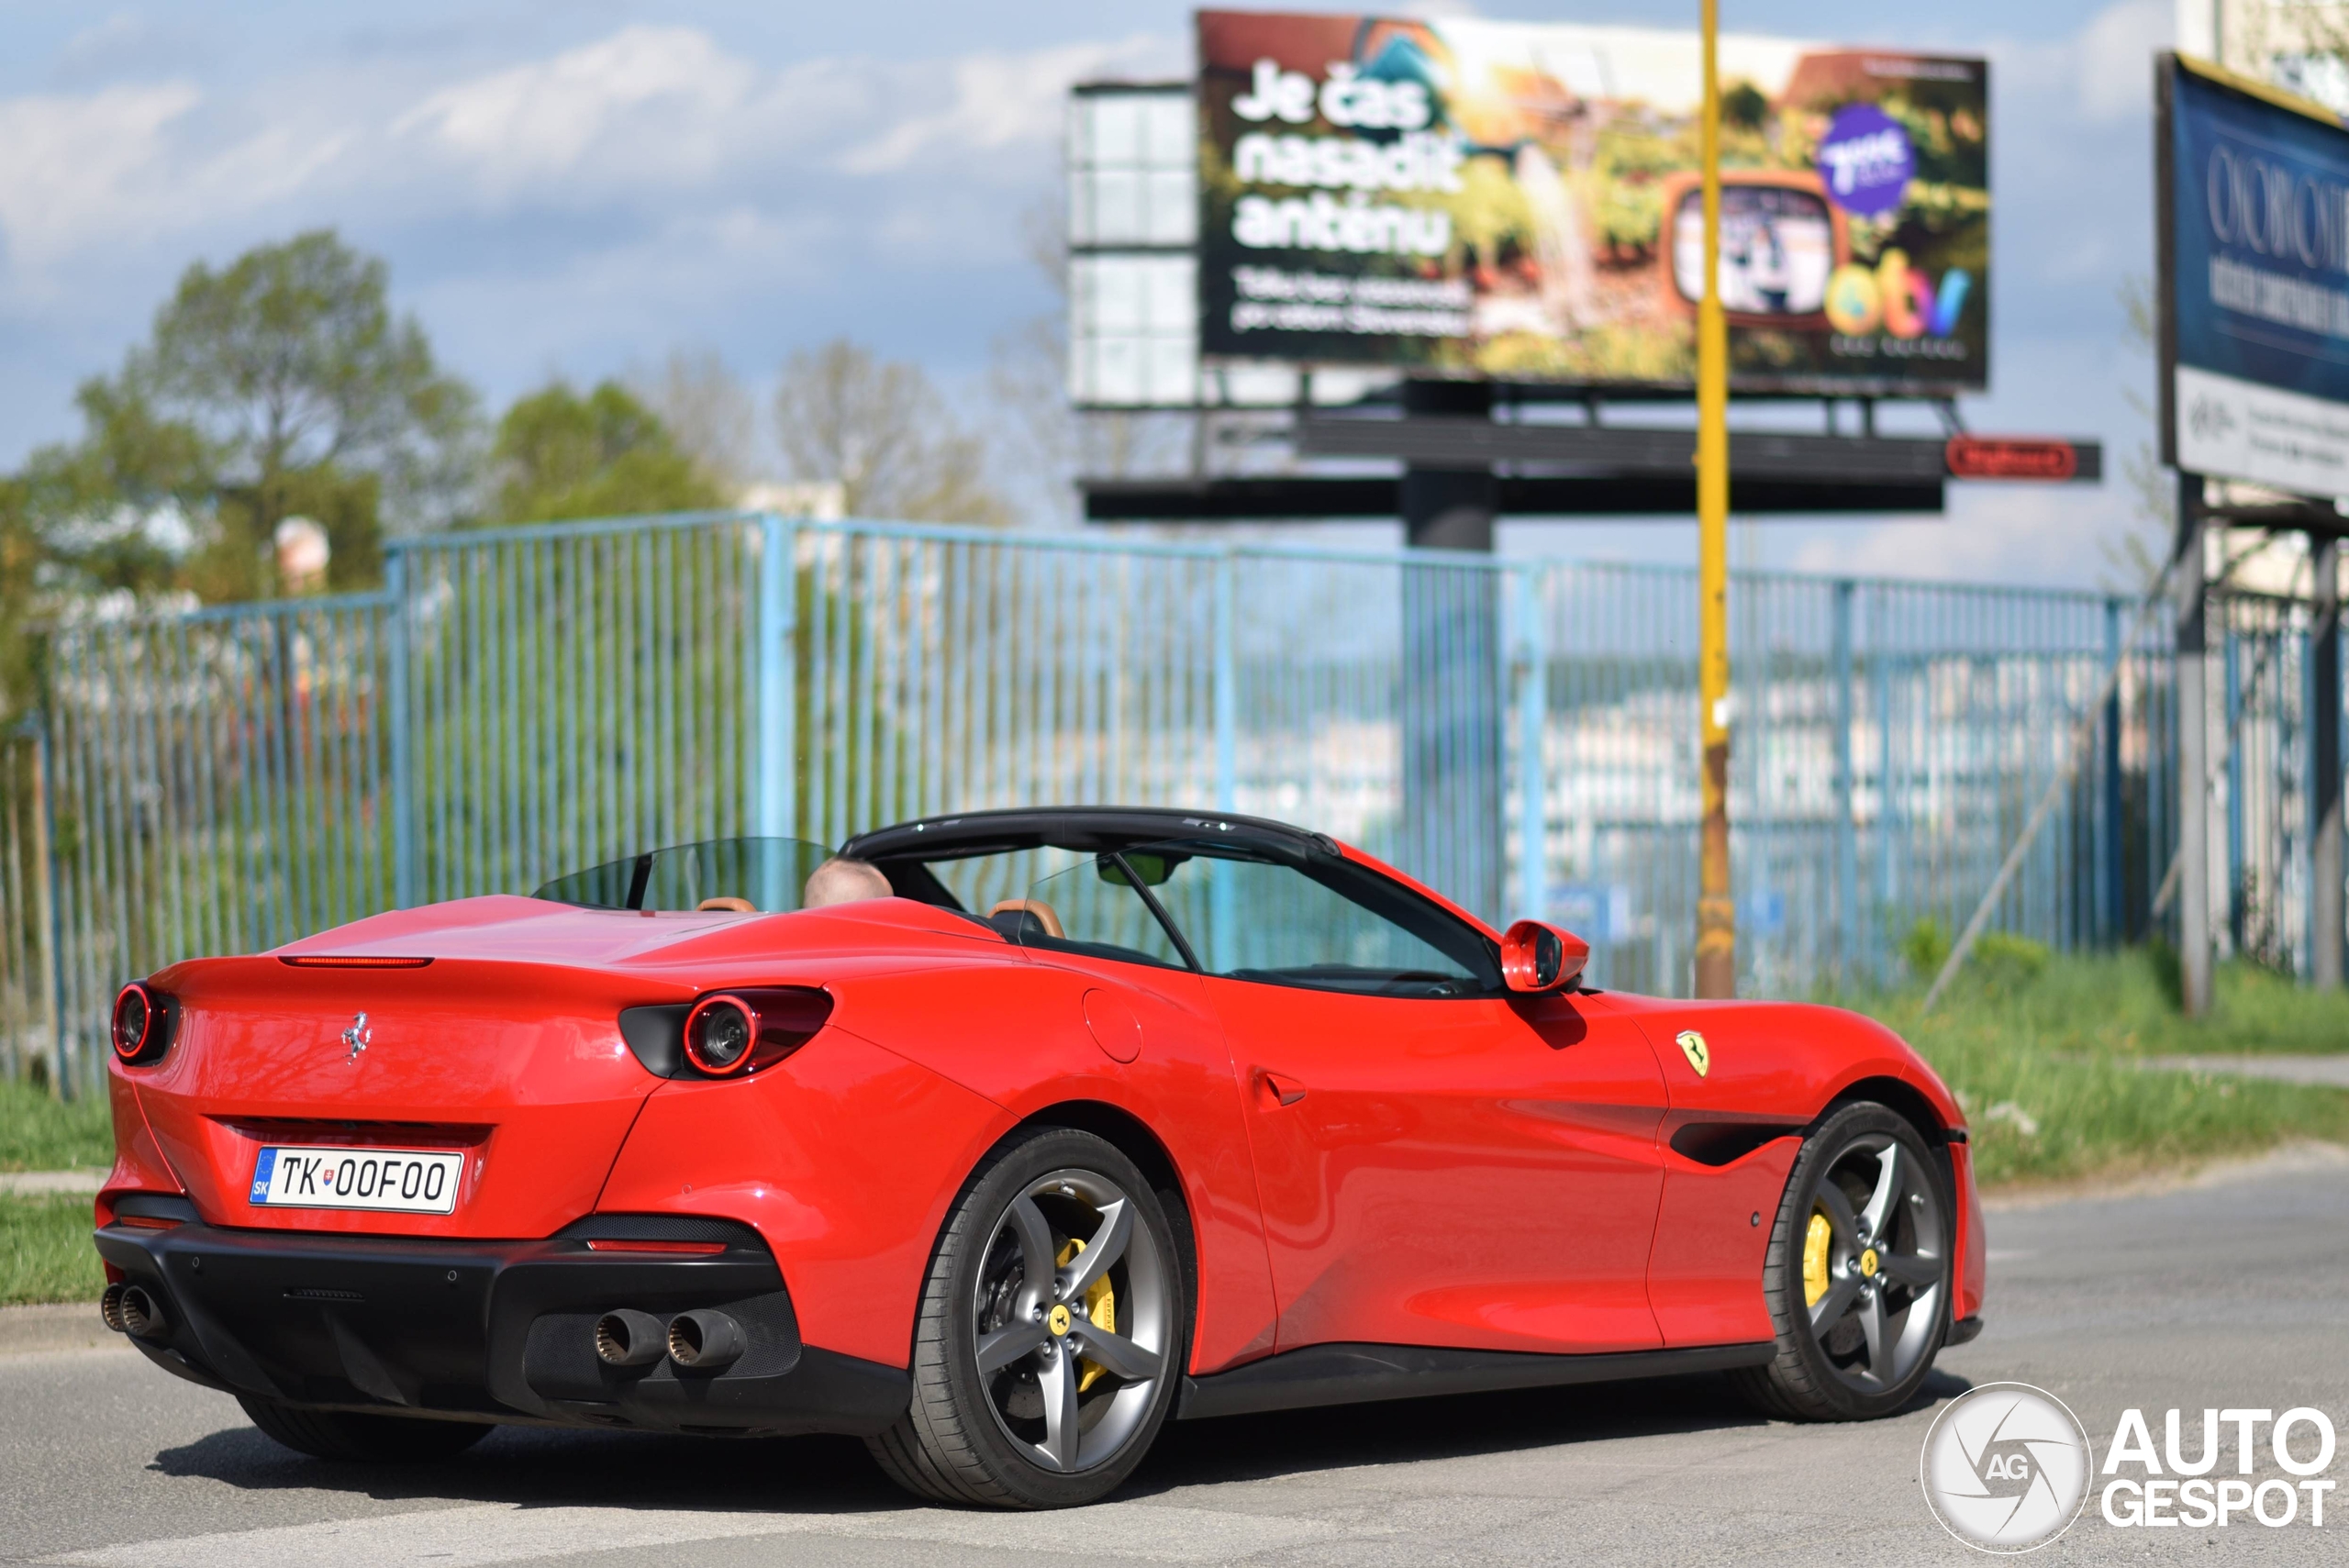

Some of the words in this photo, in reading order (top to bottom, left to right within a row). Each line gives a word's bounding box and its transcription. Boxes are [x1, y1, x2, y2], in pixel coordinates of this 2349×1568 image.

[1231, 59, 1316, 123] Je
[1319, 61, 1430, 128] čas
[253, 1181, 268, 1195] SK
[283, 1157, 322, 1195] TK
